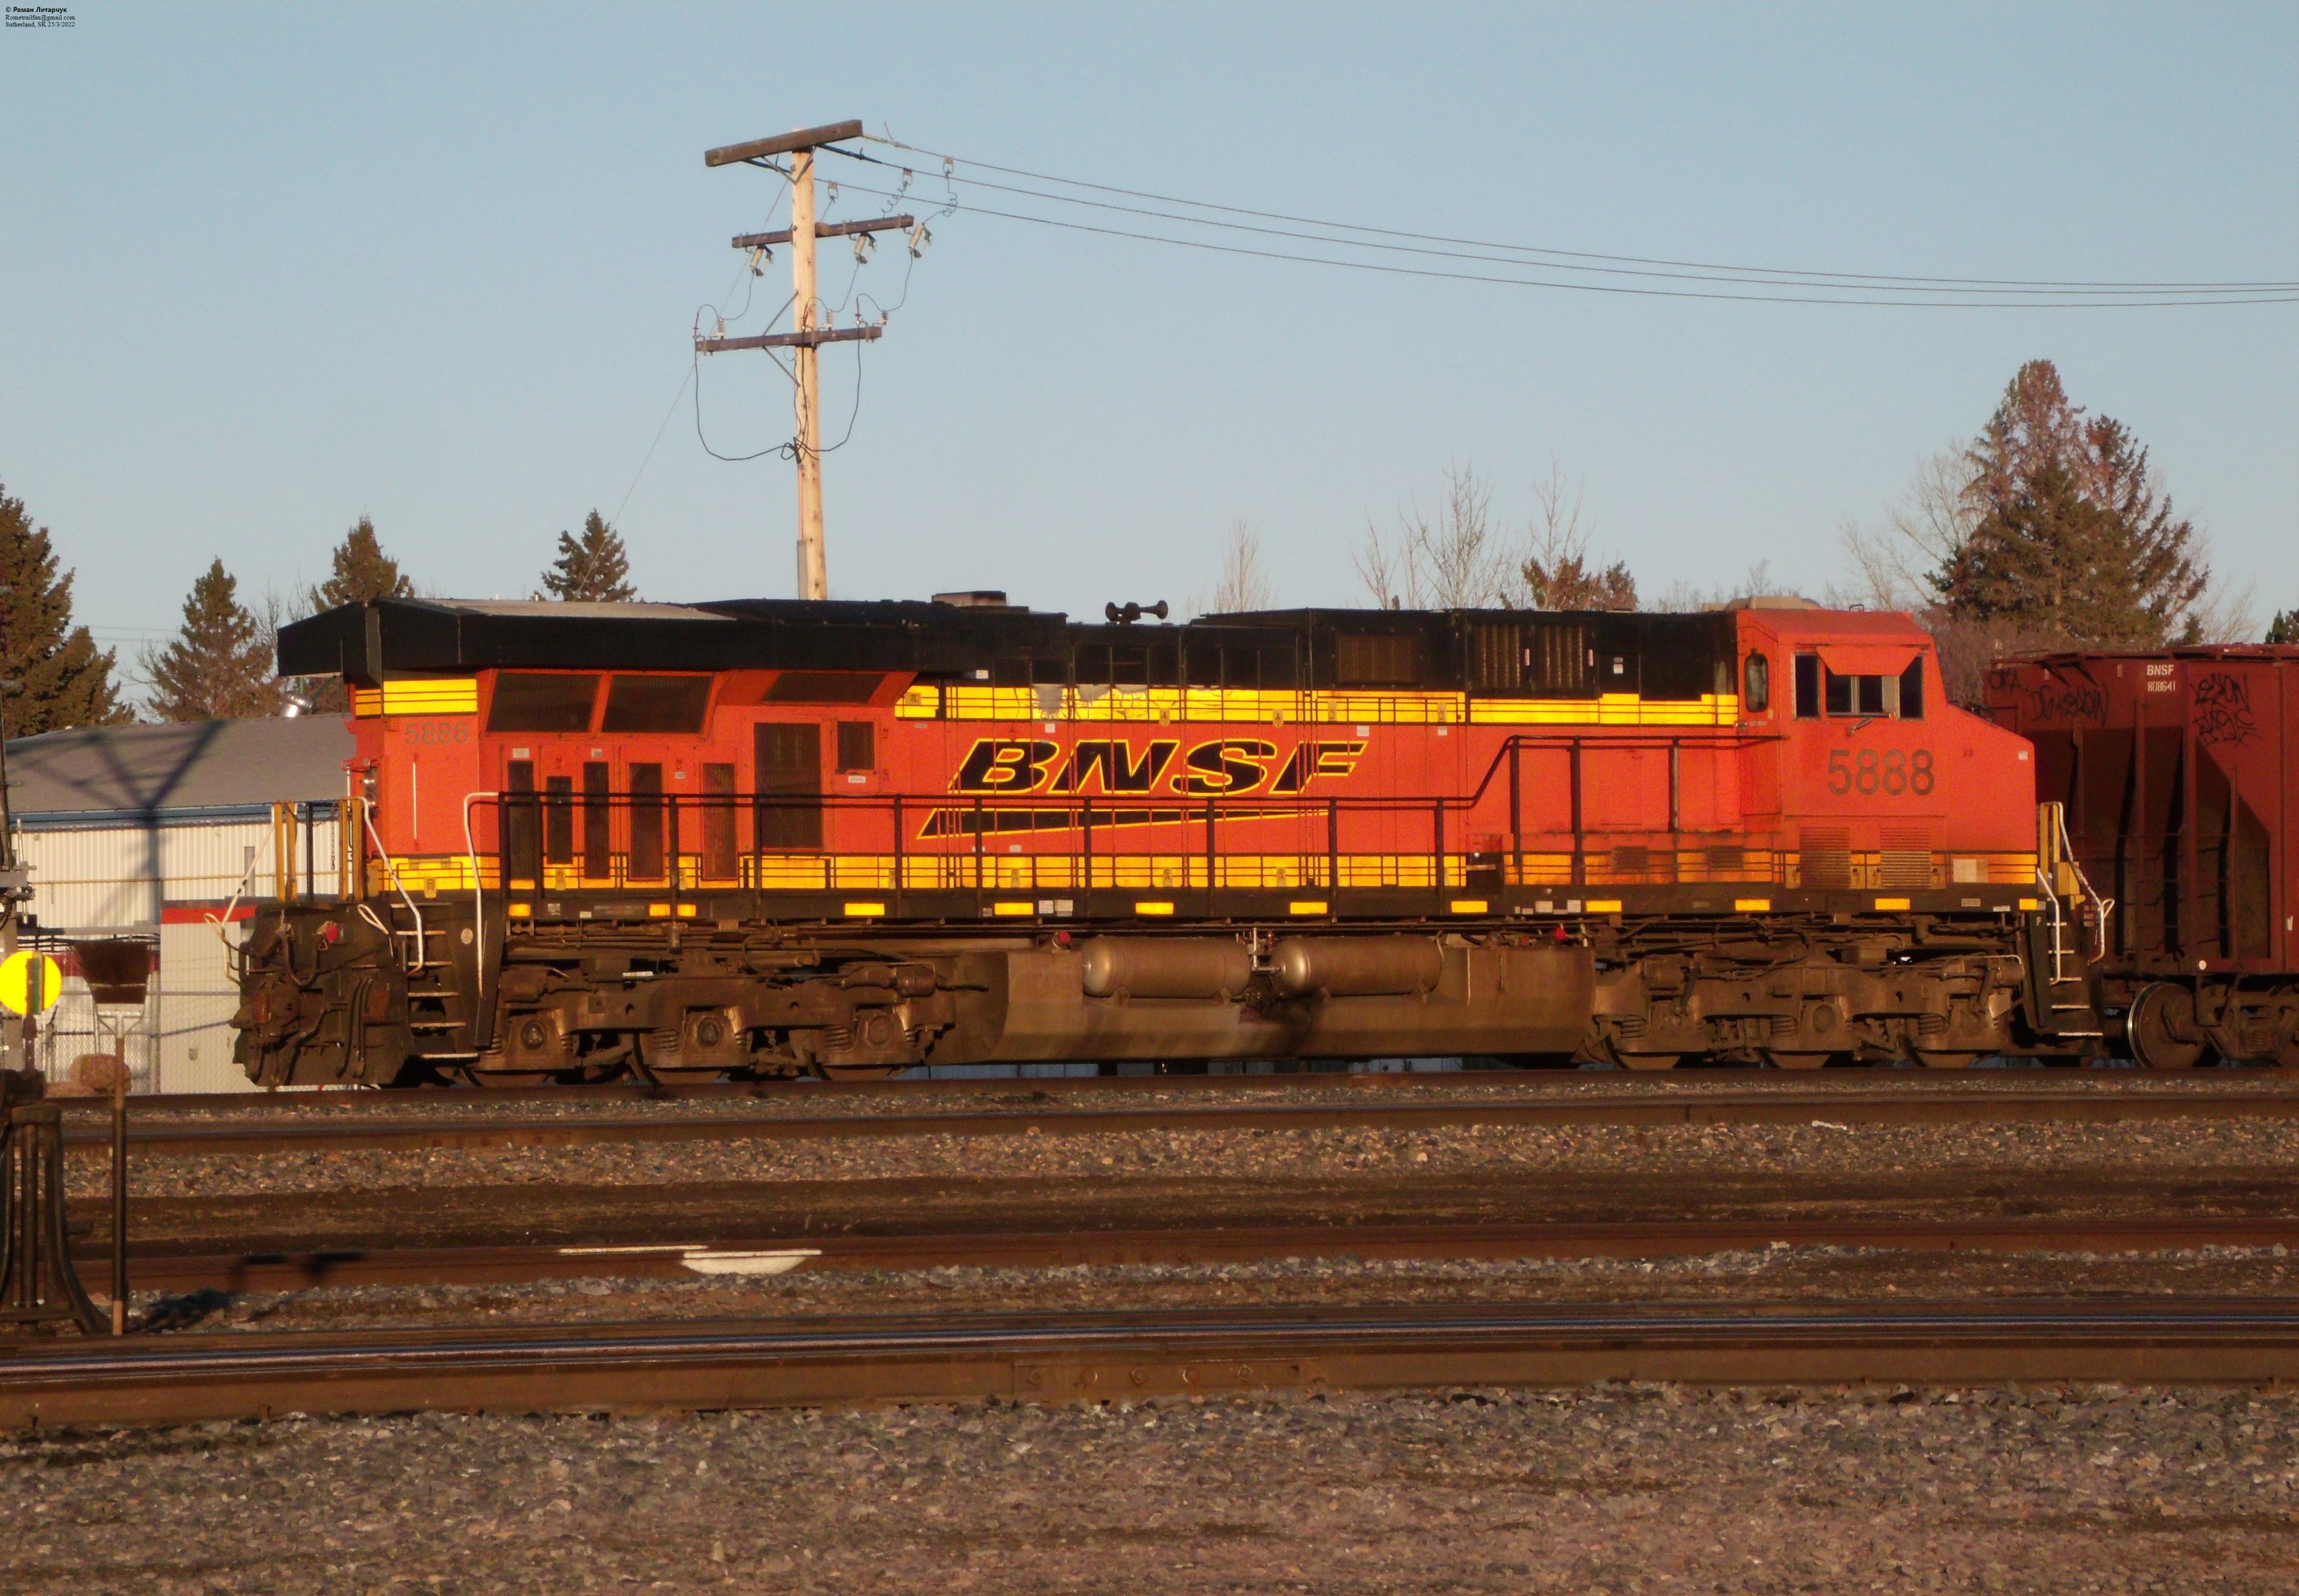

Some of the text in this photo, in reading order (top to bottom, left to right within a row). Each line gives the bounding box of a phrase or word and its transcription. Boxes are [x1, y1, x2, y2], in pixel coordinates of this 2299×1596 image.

[2147, 664, 2175, 675] BNSF
[2147, 680, 2176, 692] 808641
[405, 721, 469, 745] 5888
[947, 738, 1369, 797] BNSF
[1827, 748, 1935, 796] 5888
